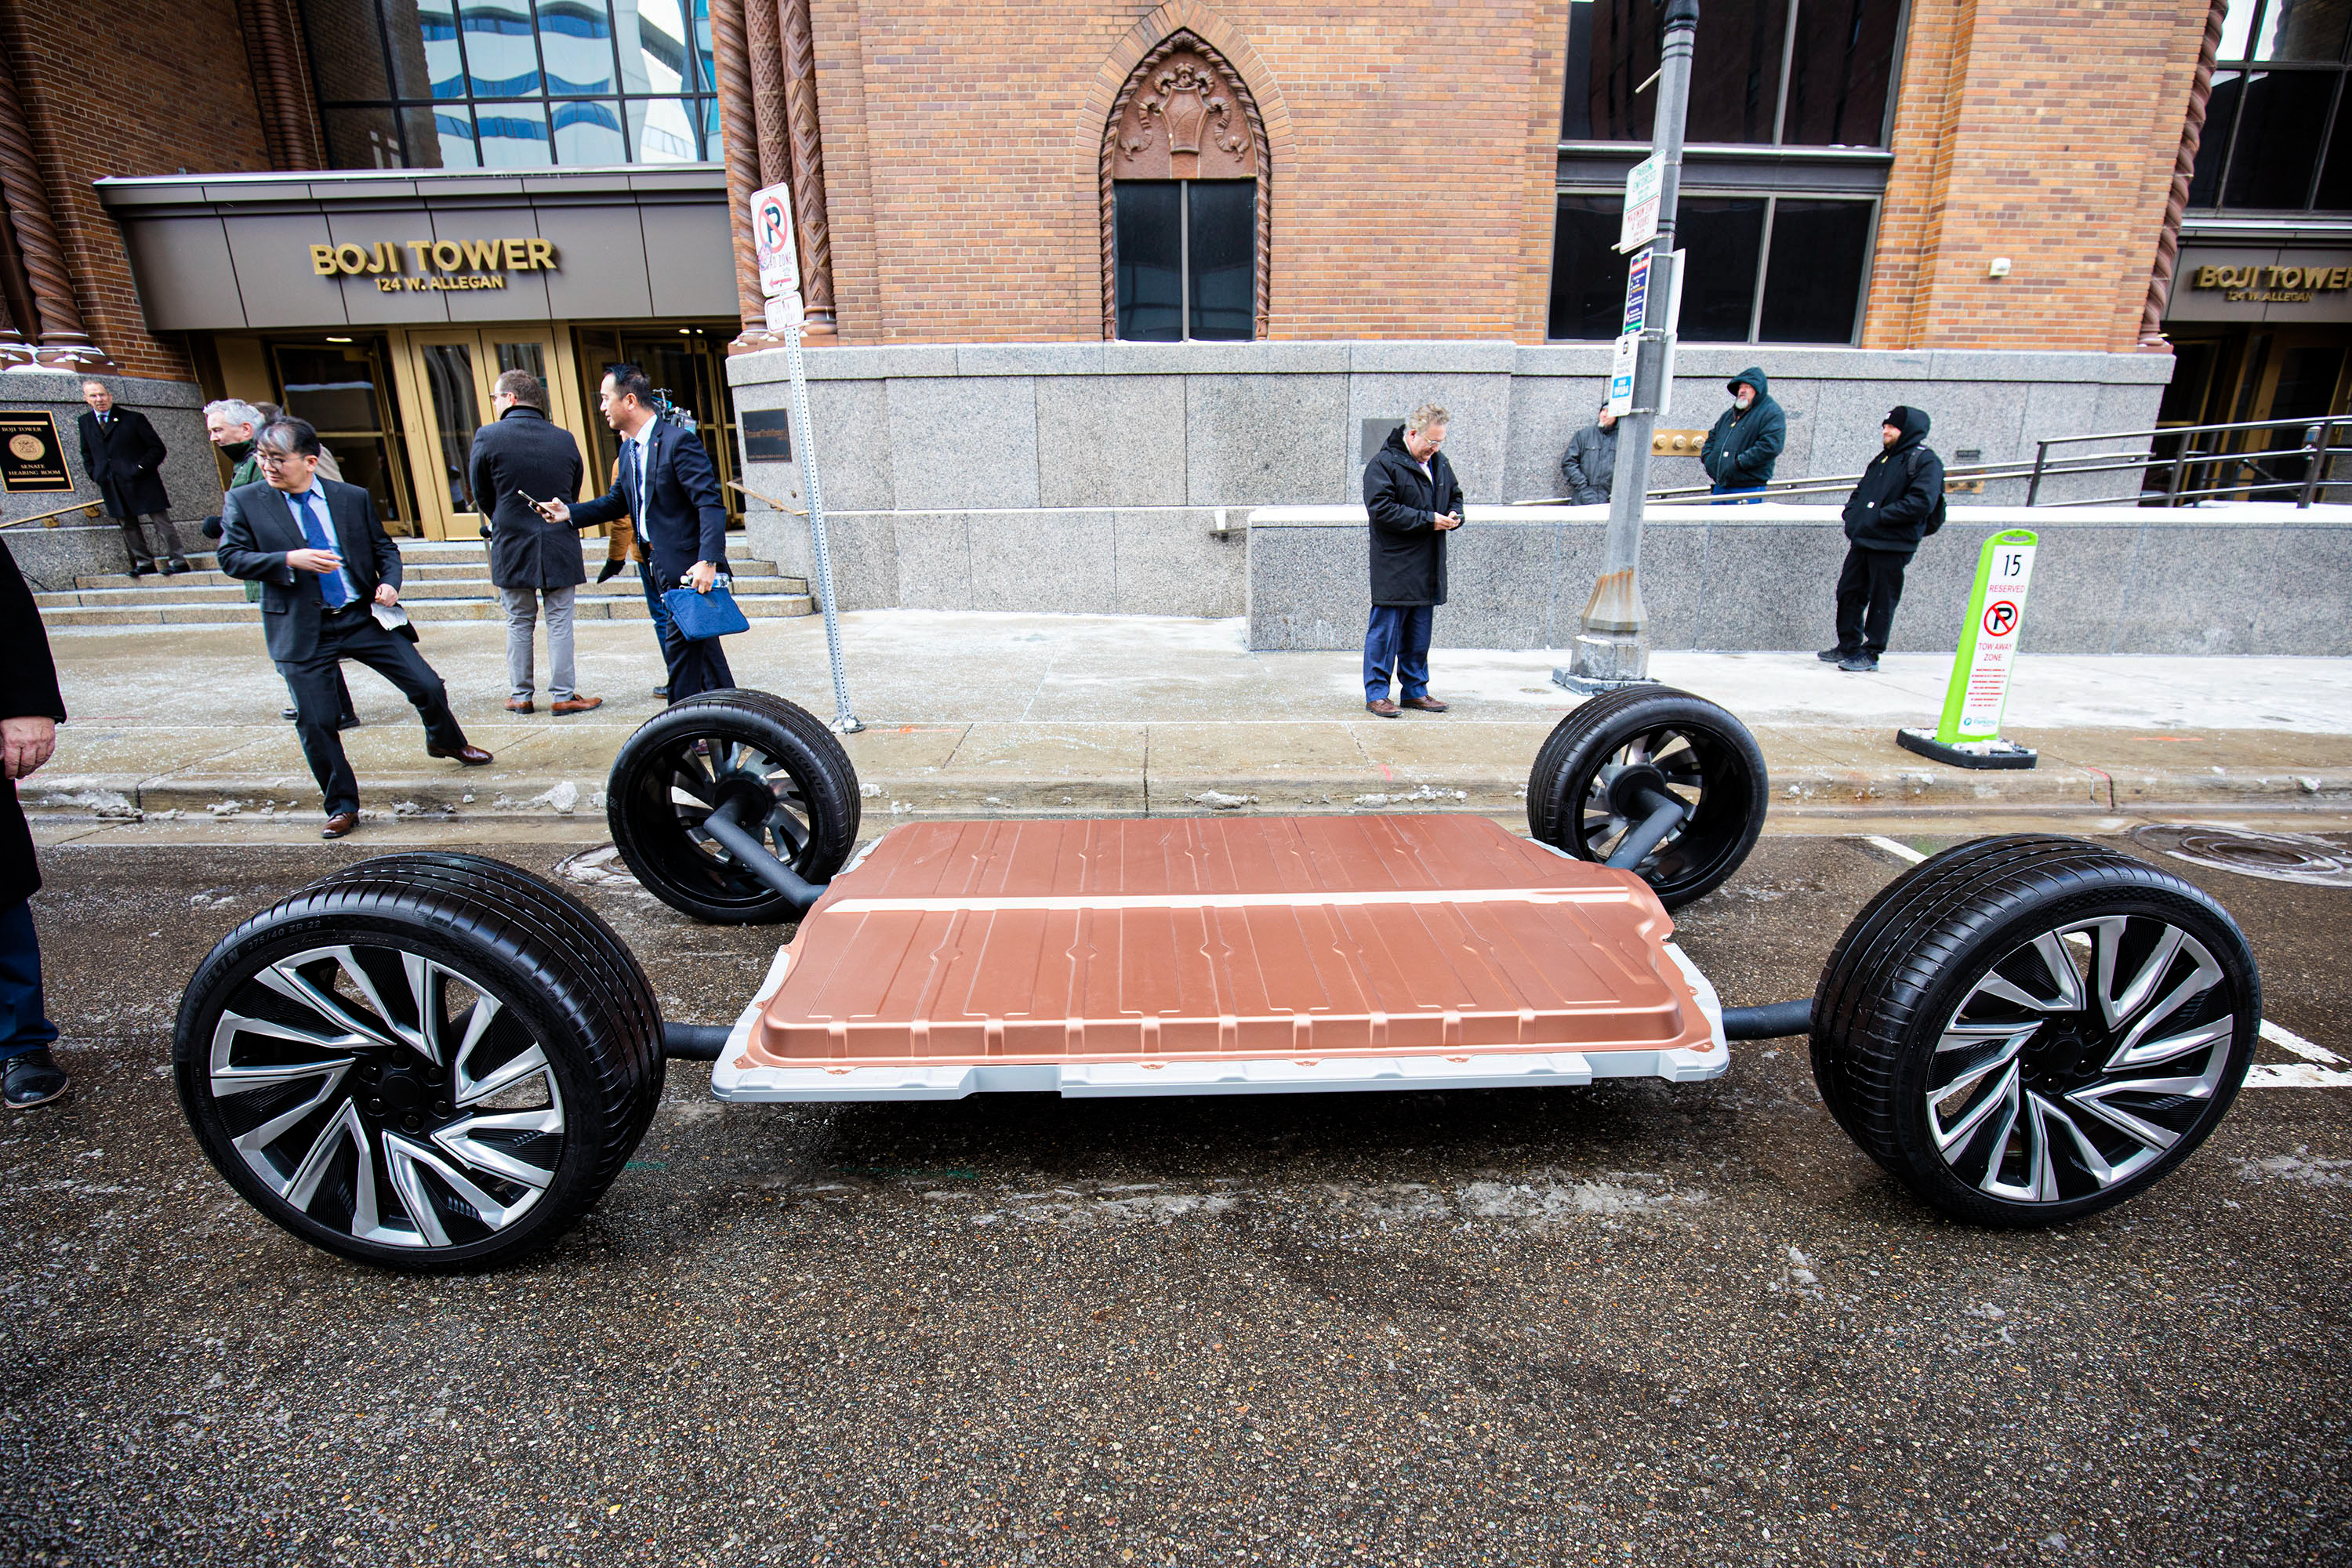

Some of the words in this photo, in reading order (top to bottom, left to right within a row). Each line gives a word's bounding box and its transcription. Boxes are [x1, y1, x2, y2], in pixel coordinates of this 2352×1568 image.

[309, 241, 399, 275] BOJI
[406, 238, 557, 272] TOWER
[373, 277, 401, 292] 124
[405, 277, 426, 291] W.
[430, 274, 504, 290] ALLEGAN
[2199, 265, 2259, 288] BOJI
[2259, 292, 2313, 302] ALLEGAN
[2004, 554, 2021, 576] 15
[1988, 584, 2025, 593] RESERVED
[1978, 642, 1994, 651] TOW
[1994, 642, 2013, 651] AWAY
[1984, 653, 2002, 662] ZONE
[785, 744, 826, 795] MICHELIN
[248, 927, 285, 950] 275/40
[289, 924, 303, 934] ZR
[307, 920, 321, 929] 22
